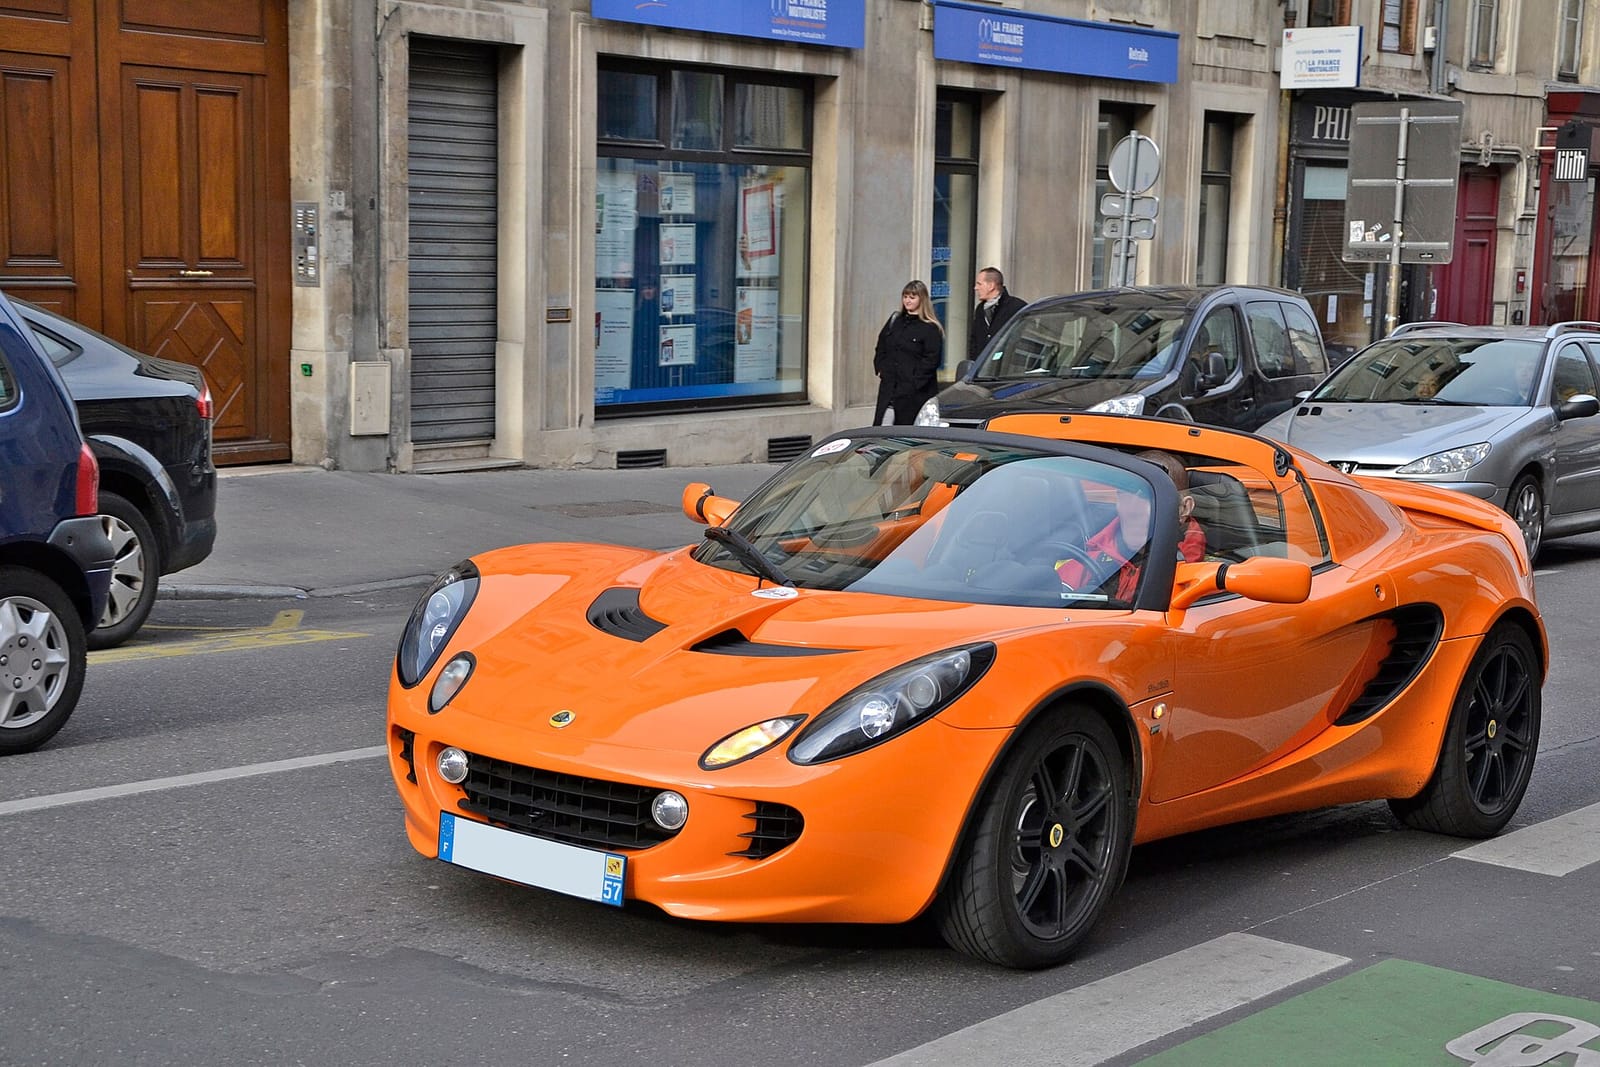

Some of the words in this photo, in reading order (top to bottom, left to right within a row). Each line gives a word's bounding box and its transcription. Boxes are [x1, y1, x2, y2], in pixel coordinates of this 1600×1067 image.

[788, 5, 826, 21] MUTUALISTE
[992, 21, 1001, 32] LA
[1002, 22, 1024, 35] FRANCE
[992, 32, 1024, 46] MUTUALISTE
[1311, 105, 1351, 141] PHI
[443, 841, 449, 853] F
[603, 880, 622, 901] 57
